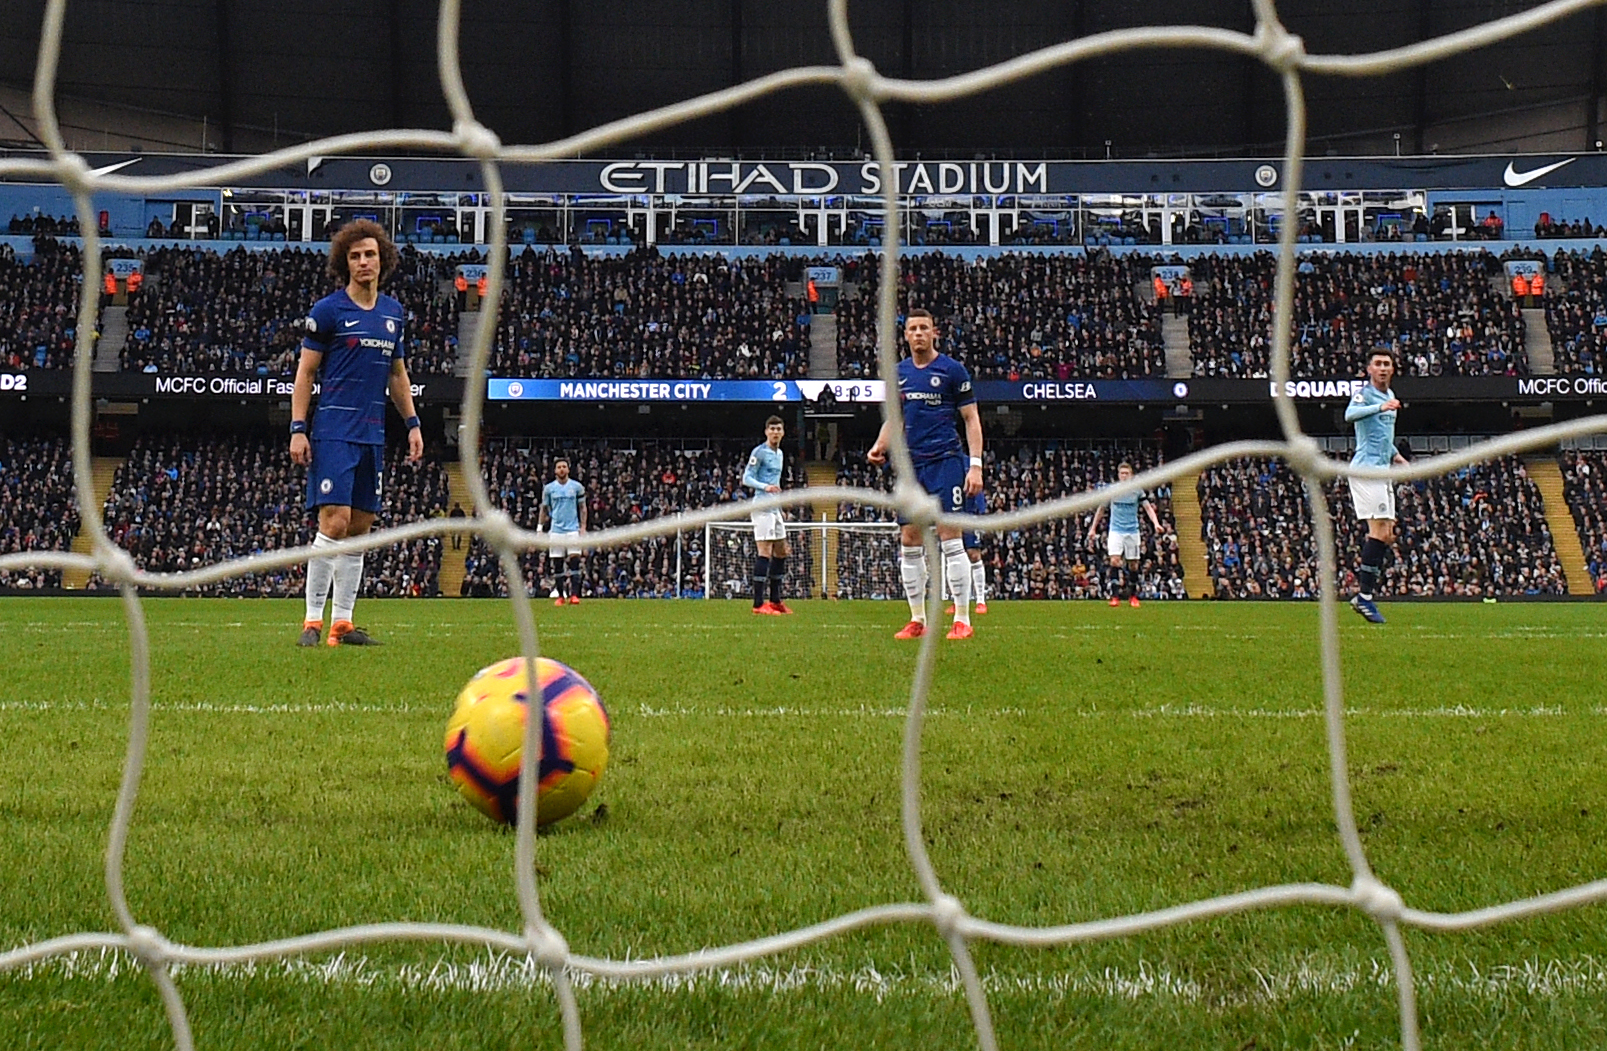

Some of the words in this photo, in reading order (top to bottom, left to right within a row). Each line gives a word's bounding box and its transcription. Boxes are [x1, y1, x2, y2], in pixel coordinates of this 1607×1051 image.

[600, 161, 839, 194] ETIHAD
[860, 161, 1048, 194] STADIUM
[814, 271, 832, 281] 237
[155, 376, 207, 394] MCFC
[209, 376, 262, 394] Official
[559, 382, 672, 399] MANCHESTER
[674, 382, 712, 399] CITY
[772, 381, 788, 401] 2
[1022, 382, 1098, 400] CHELSEA
[1518, 379, 1571, 395] MCFC
[952, 485, 963, 505] 8
